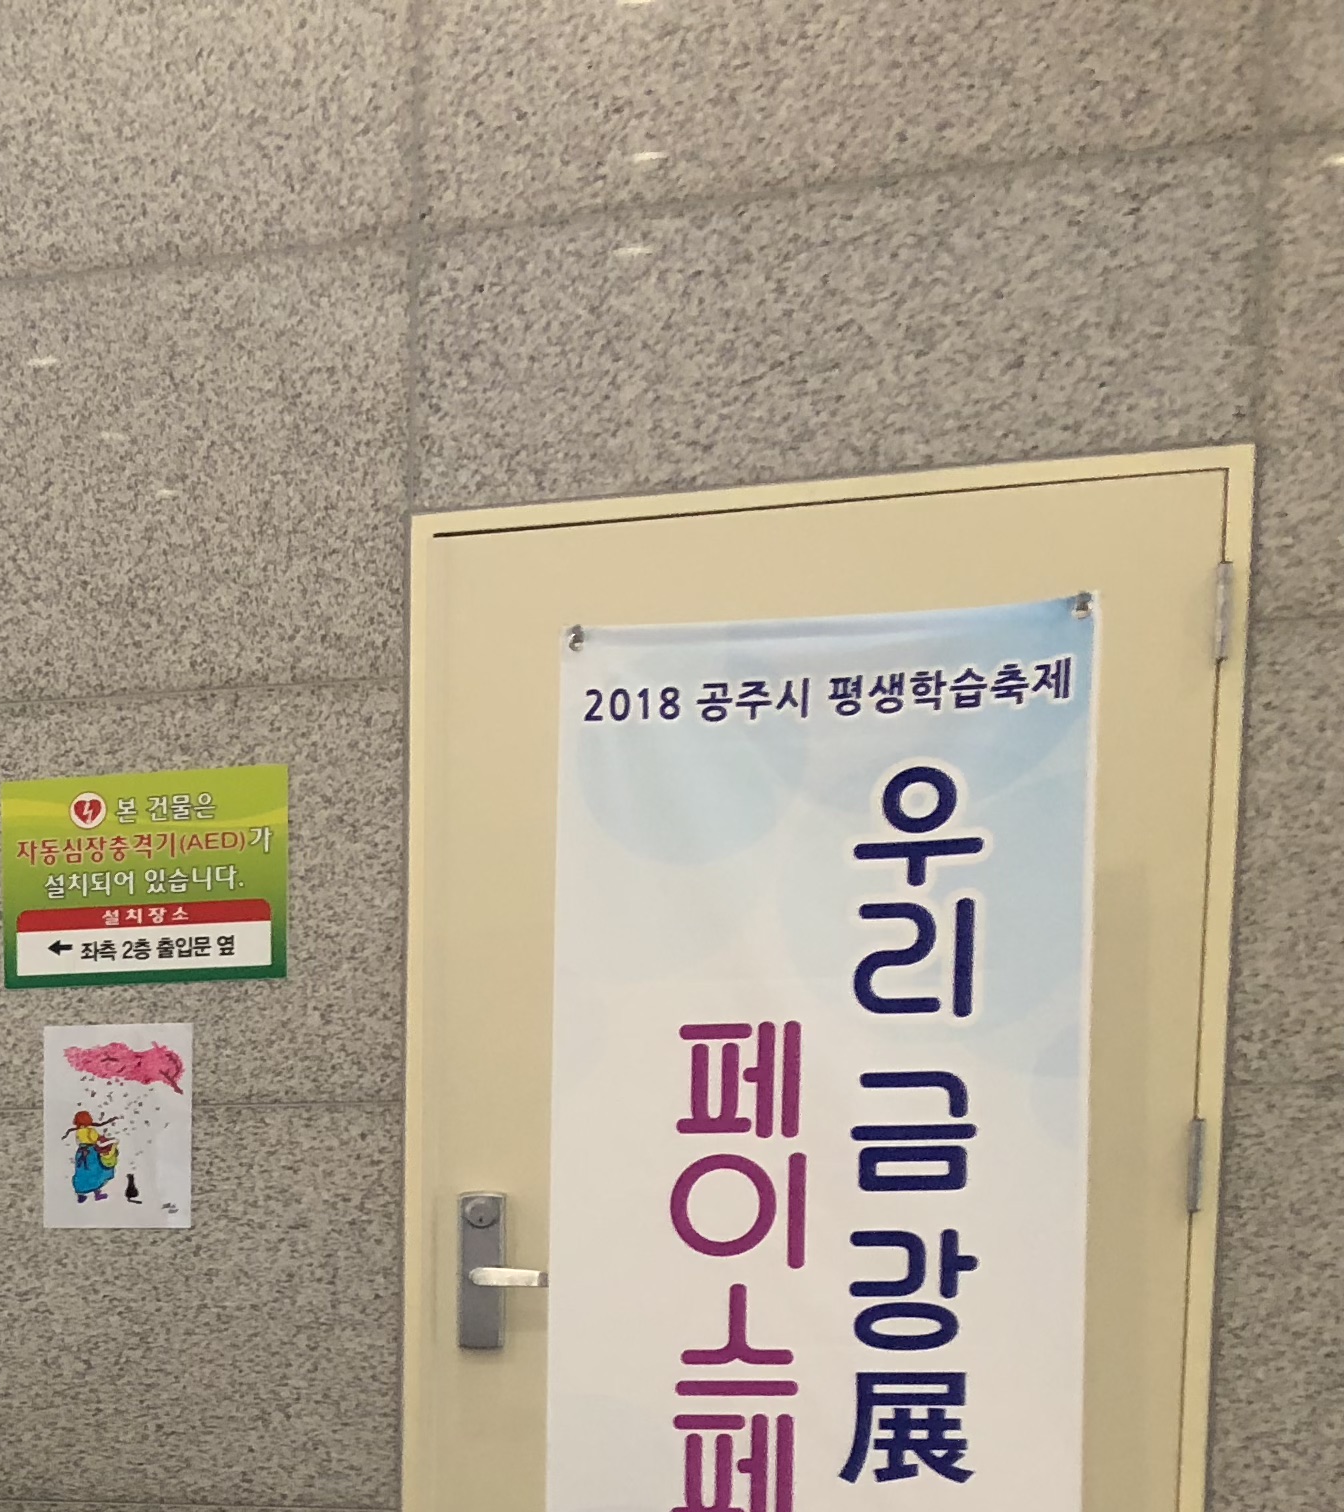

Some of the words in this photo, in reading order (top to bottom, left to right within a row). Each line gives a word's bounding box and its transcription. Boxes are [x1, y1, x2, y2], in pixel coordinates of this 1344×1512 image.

[583, 686, 683, 721] 2018
[696, 678, 811, 722] 공주시
[827, 656, 1072, 714] 평생학습축제
[115, 797, 138, 823] 본
[148, 792, 215, 822] 건물은
[44, 869, 135, 899] 설치되어
[144, 866, 245, 894] 있습니다.
[101, 906, 190, 926] 설치장소
[80, 938, 117, 962] 좌측
[121, 938, 152, 960] 2층
[156, 936, 213, 961] 출입문
[216, 934, 236, 957] 옆
